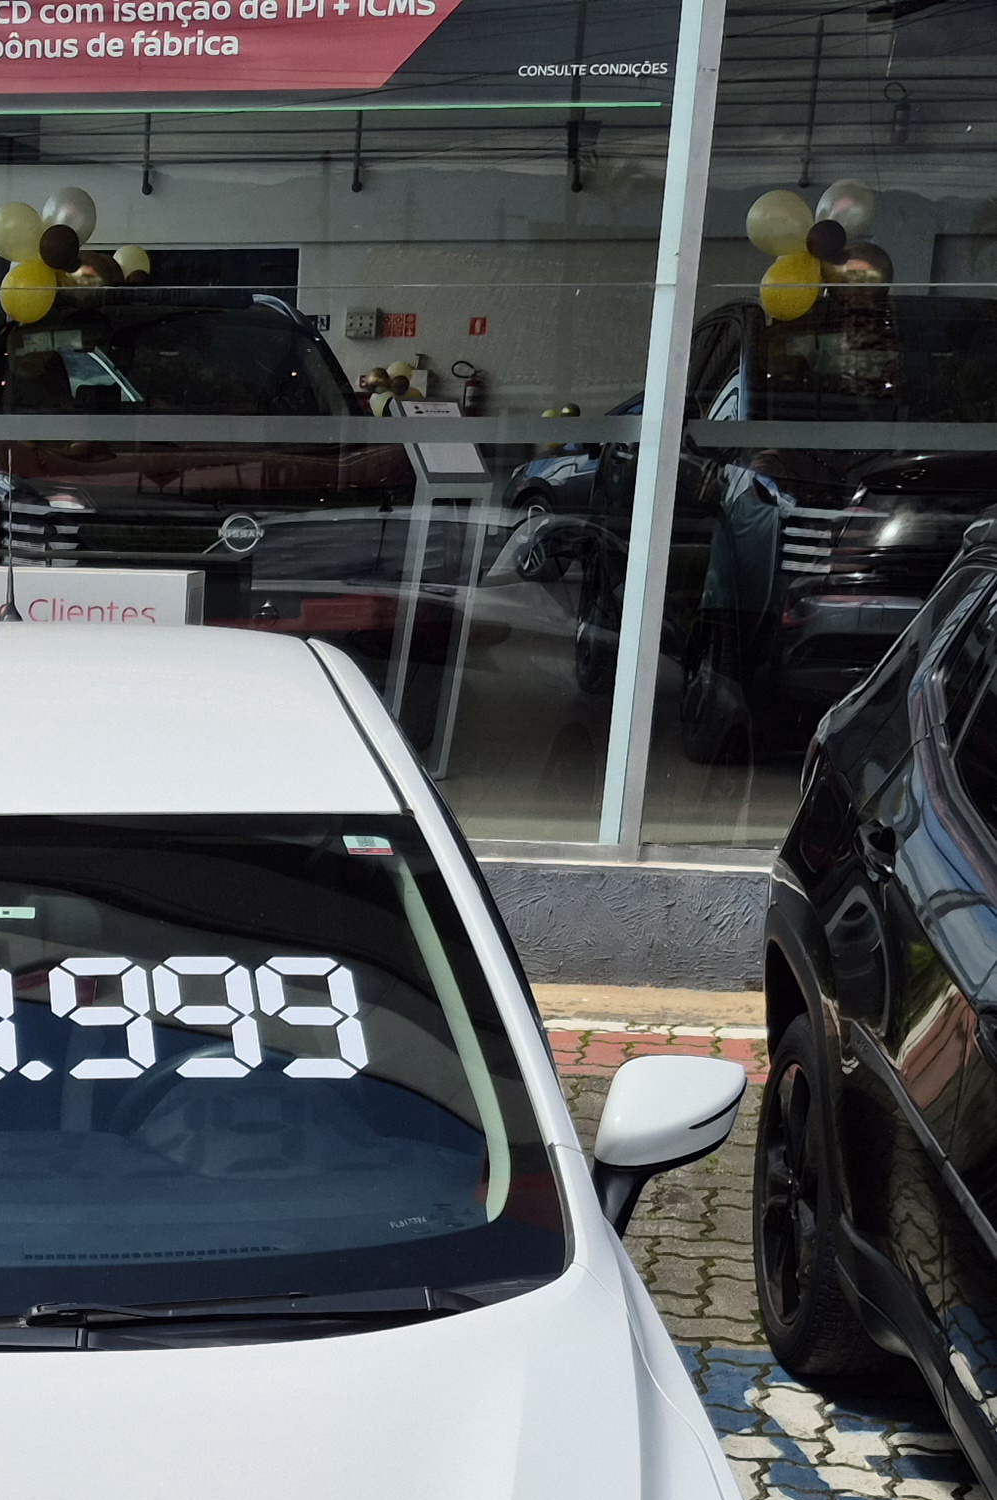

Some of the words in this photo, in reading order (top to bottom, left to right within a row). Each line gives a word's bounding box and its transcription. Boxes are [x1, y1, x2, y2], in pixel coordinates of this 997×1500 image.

[39, 2, 104, 24] com
[239, 0, 278, 20] de
[286, 0, 325, 19] IPI
[333, 0, 350, 16] +
[358, 0, 436, 17] ICMS
[86, 32, 124, 58] de
[130, 30, 239, 57] fábrica
[518, 64, 587, 77] CONSULTE
[589, 60, 668, 77] CONDIÇÕES
[217, 528, 265, 538] NISSAN
[28, 598, 157, 624] Clientes
